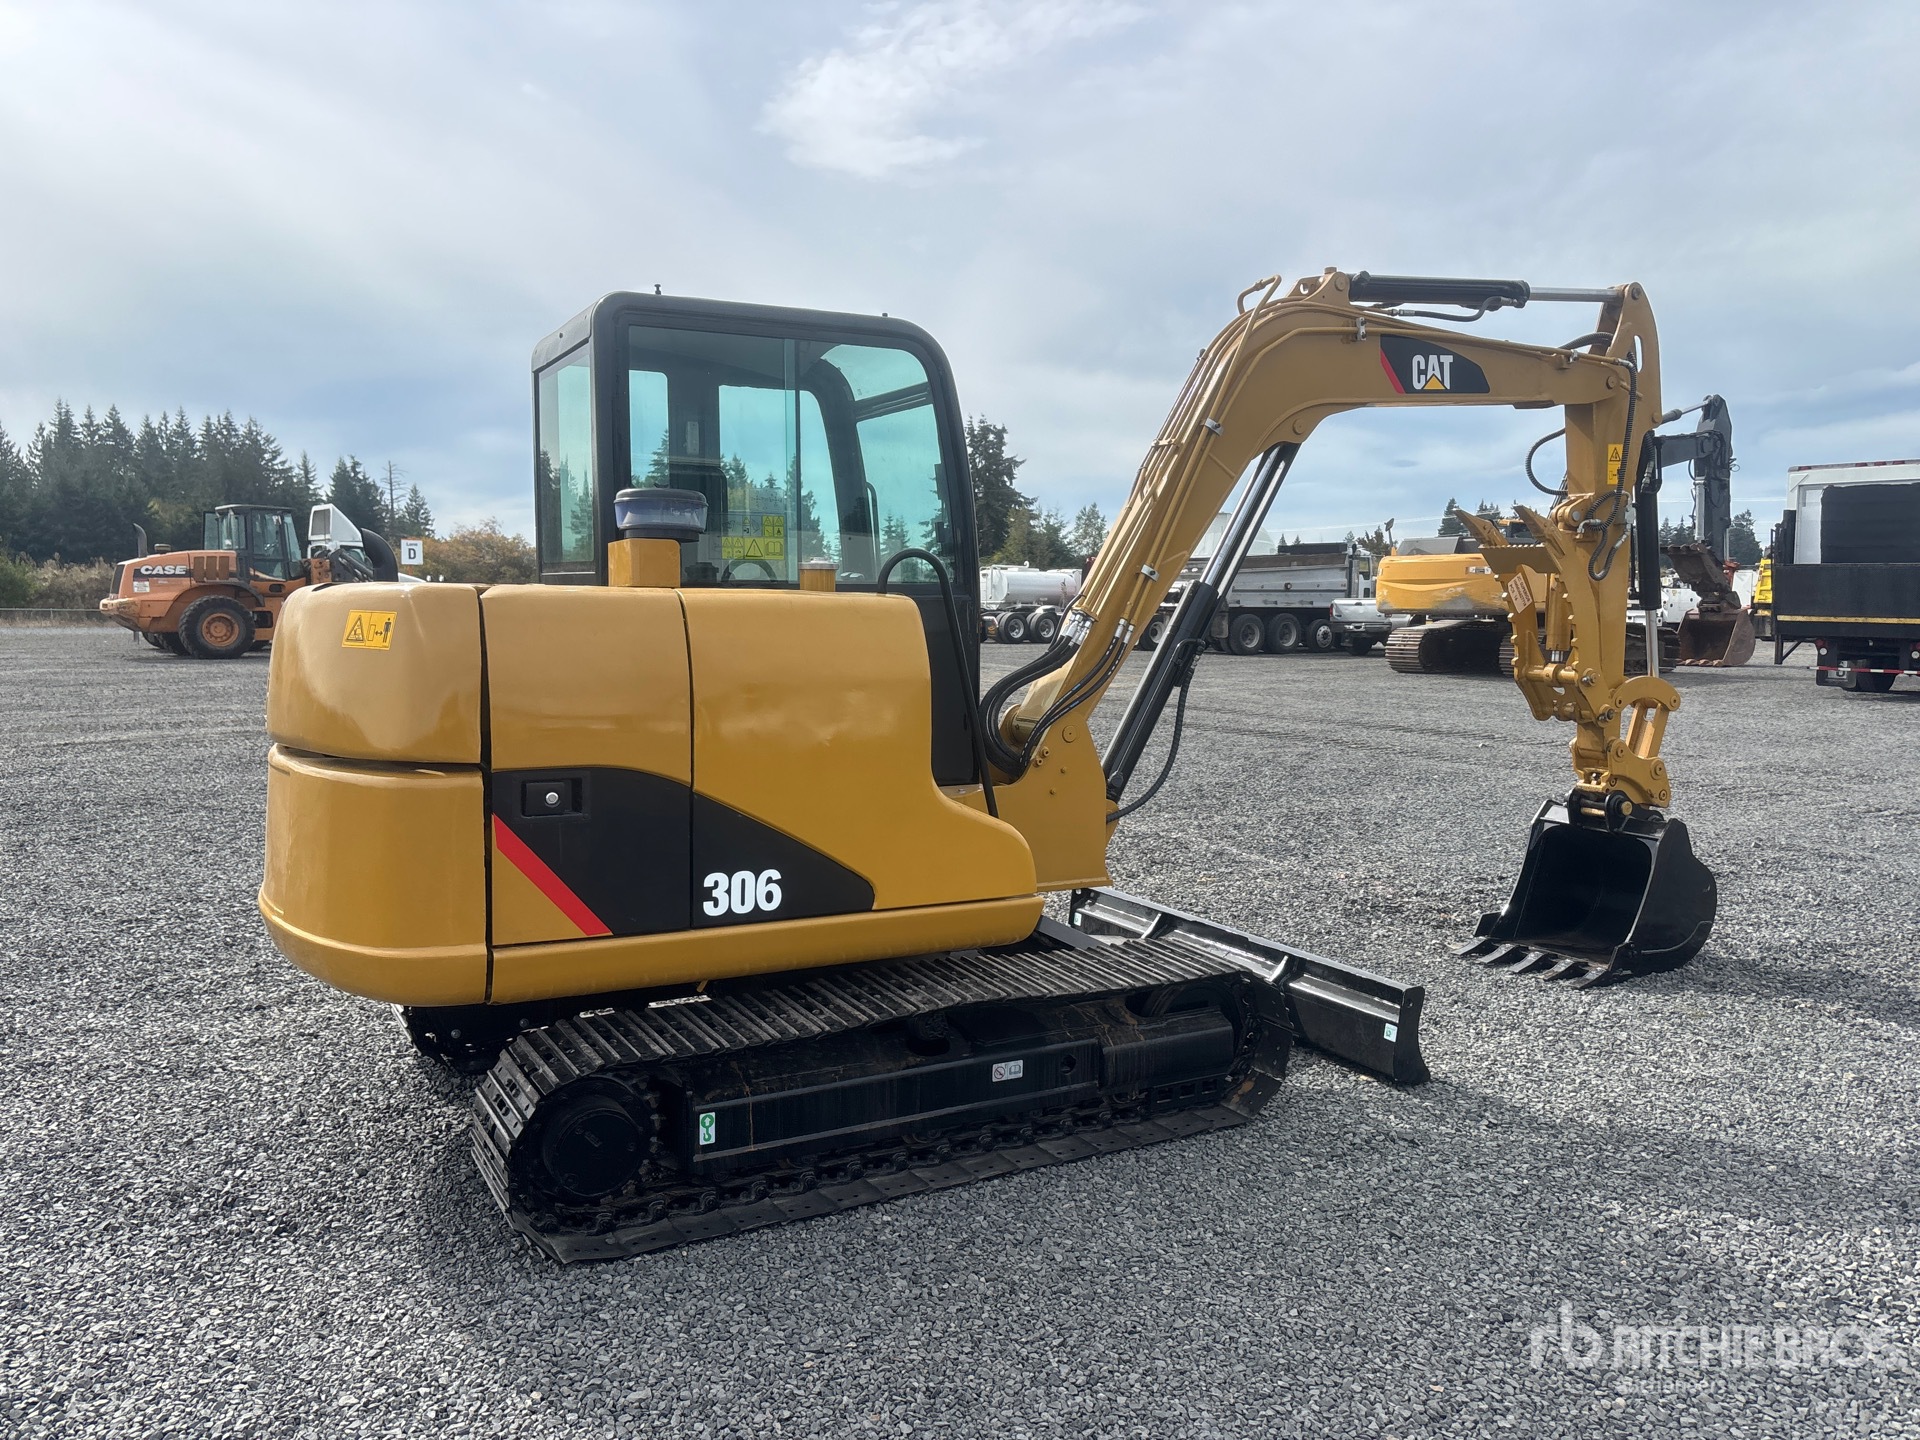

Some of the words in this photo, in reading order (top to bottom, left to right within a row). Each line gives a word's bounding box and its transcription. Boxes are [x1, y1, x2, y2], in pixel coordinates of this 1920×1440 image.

[1412, 354, 1454, 390] CAT
[408, 547, 417, 559] D
[140, 565, 187, 574] CASE
[703, 869, 782, 917] 306
